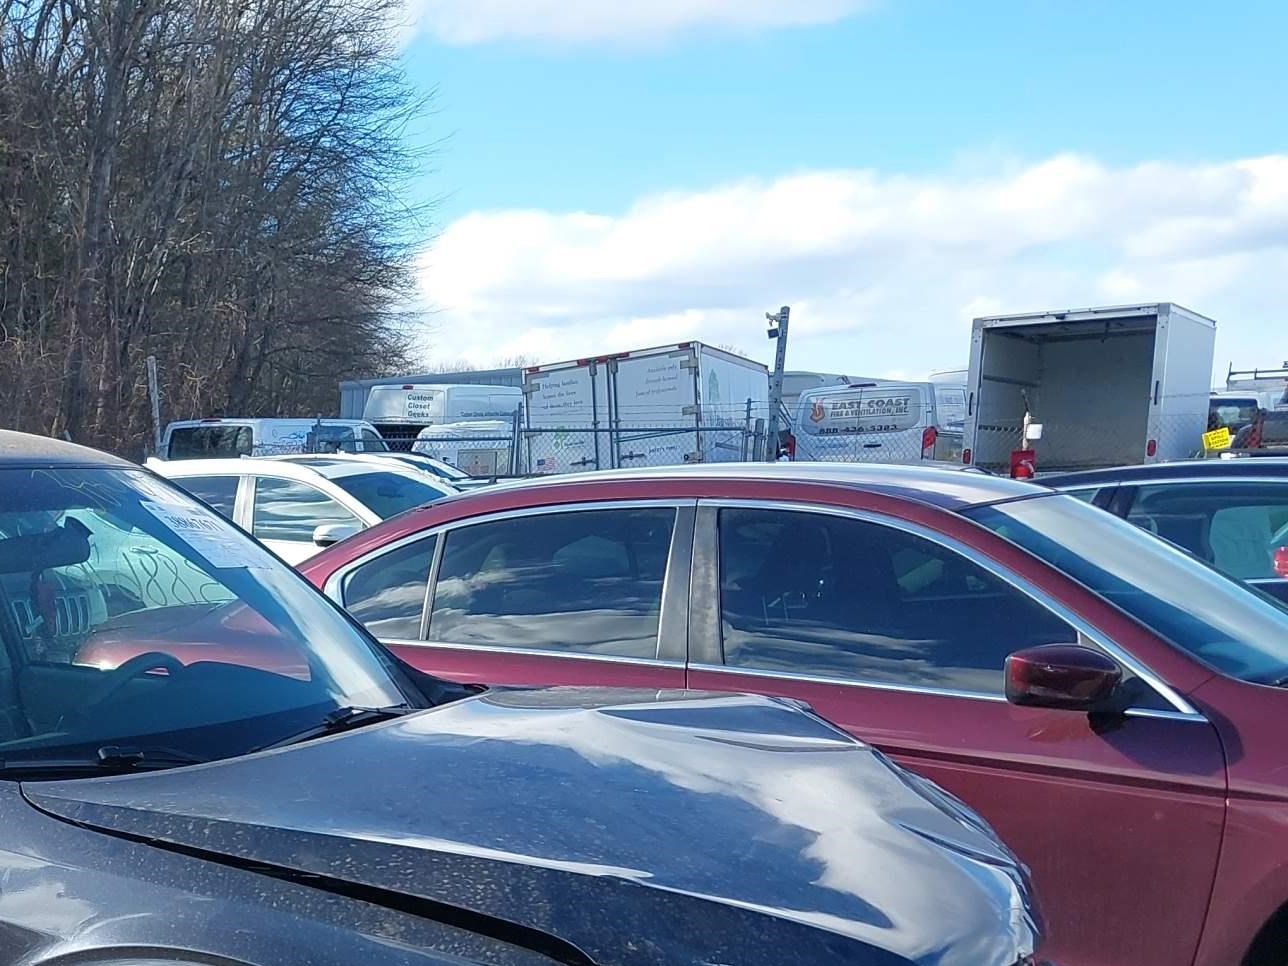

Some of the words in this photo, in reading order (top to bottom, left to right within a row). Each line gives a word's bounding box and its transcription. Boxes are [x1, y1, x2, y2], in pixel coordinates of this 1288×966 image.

[407, 402, 430, 410] Closet
[832, 401, 861, 410] EAST
[867, 398, 910, 408] COAST
